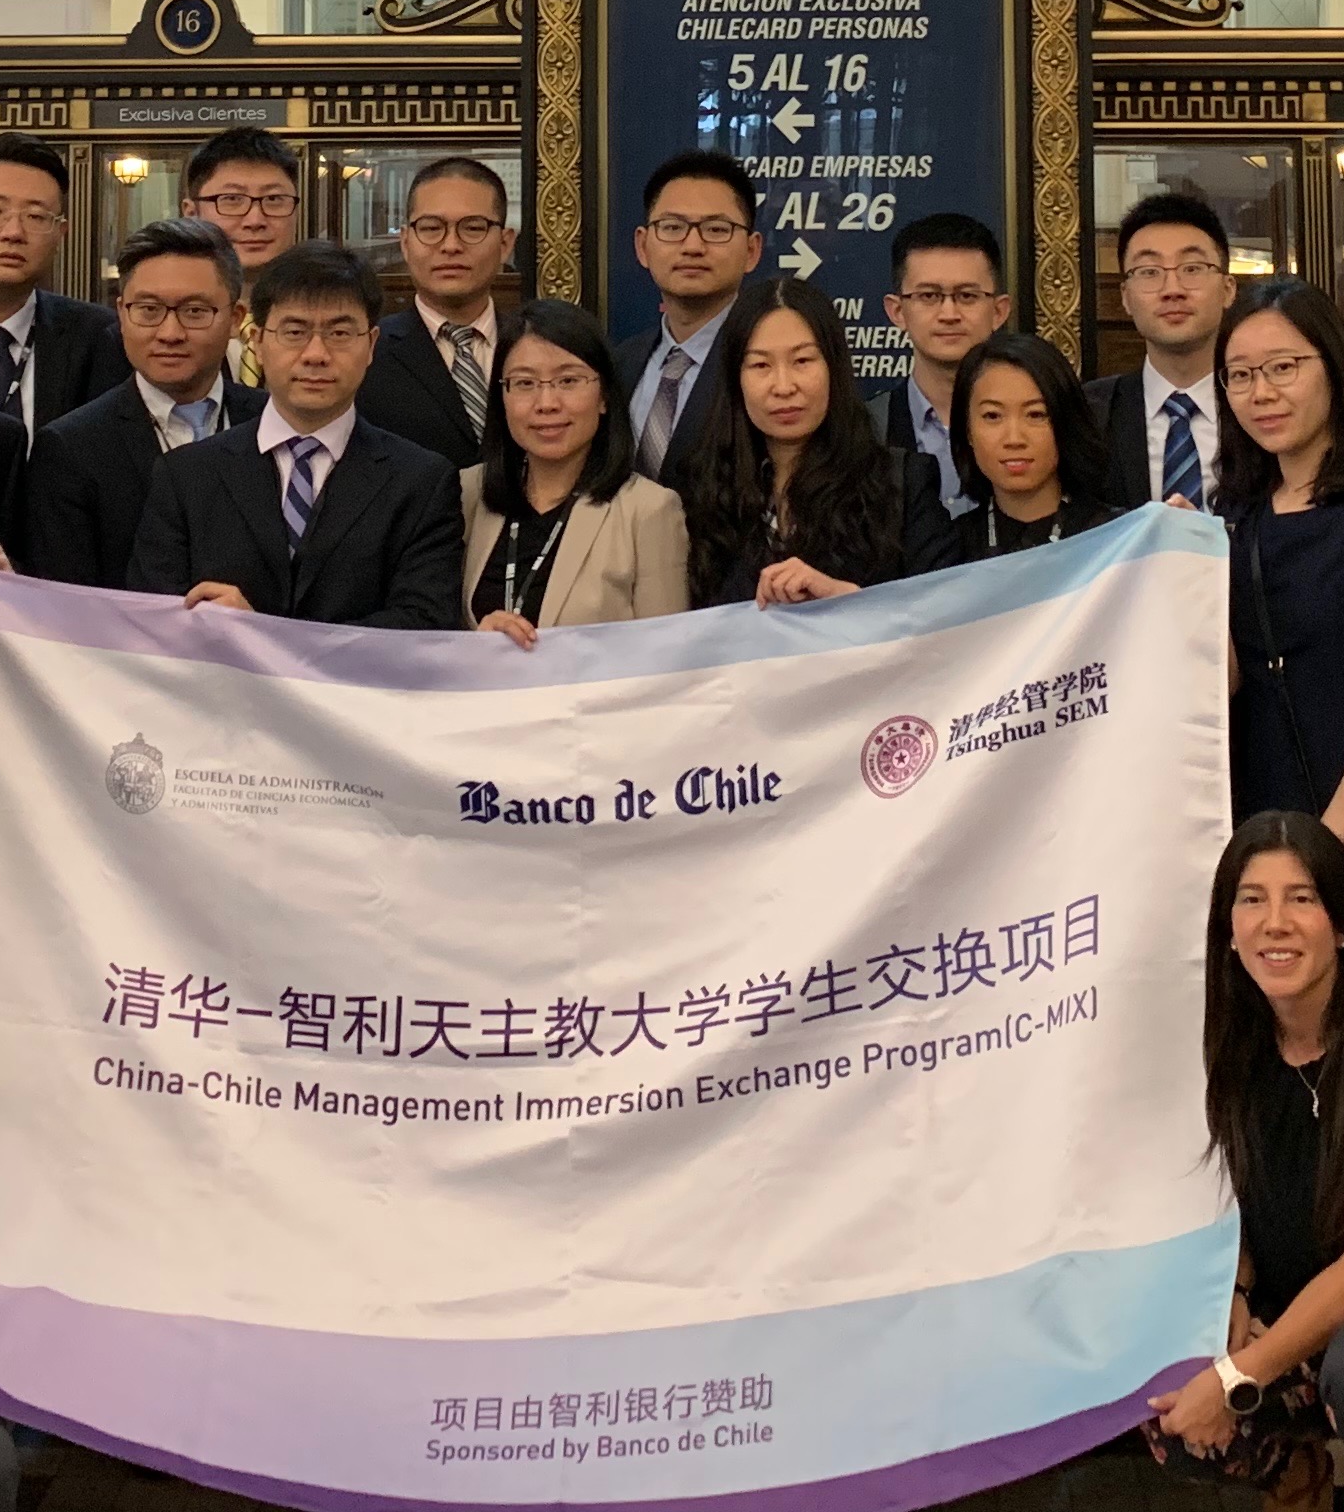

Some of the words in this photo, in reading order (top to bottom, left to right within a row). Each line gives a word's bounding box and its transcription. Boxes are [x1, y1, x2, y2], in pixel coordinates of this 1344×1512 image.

[176, 10, 201, 34] 16
[677, 18, 801, 41] CHILECARD
[808, 18, 929, 40] PERSONAS
[728, 54, 755, 91] 5
[761, 55, 809, 91] AL
[824, 54, 869, 91] 16
[119, 107, 194, 122] Exclusiva
[197, 107, 267, 121] Clientes
[810, 155, 933, 178] EMPRESAS
[775, 192, 827, 230] AL
[838, 192, 896, 232] 26
[831, 297, 864, 320] ON
[844, 326, 914, 349] ENERA
[851, 354, 915, 377] ERRA
[949, 662, 1108, 743] 清华经管学院
[945, 718, 1046, 762] Tsinghua
[1055, 694, 1109, 728] SEM
[173, 785, 227, 798] FACULTAD
[230, 789, 243, 799] DE
[246, 790, 296, 803] CIENCIAS
[299, 792, 372, 808] ECONÓMICAS
[175, 768, 233, 785] ESCUELA
[238, 774, 256, 786] DE
[259, 775, 384, 799] ADMINISTRACIÓN
[456, 781, 595, 825] Banco
[614, 778, 657, 822] de
[674, 762, 783, 815] Chile
[181, 799, 279, 815] ADMINISTRATIVAS
[93, 1057, 282, 1108] China-Chile
[293, 1081, 504, 1126] Management
[515, 1083, 684, 1121] Immersion
[696, 1057, 851, 1104] Exchange
[863, 986, 1099, 1074] Program(C-MIX)
[430, 1373, 773, 1432] 项目由智利银行赞助
[426, 1438, 555, 1465] Sponsored
[563, 1437, 590, 1463] by
[596, 1436, 669, 1458] Banco
[678, 1429, 706, 1450] de
[714, 1422, 773, 1448] Chile
